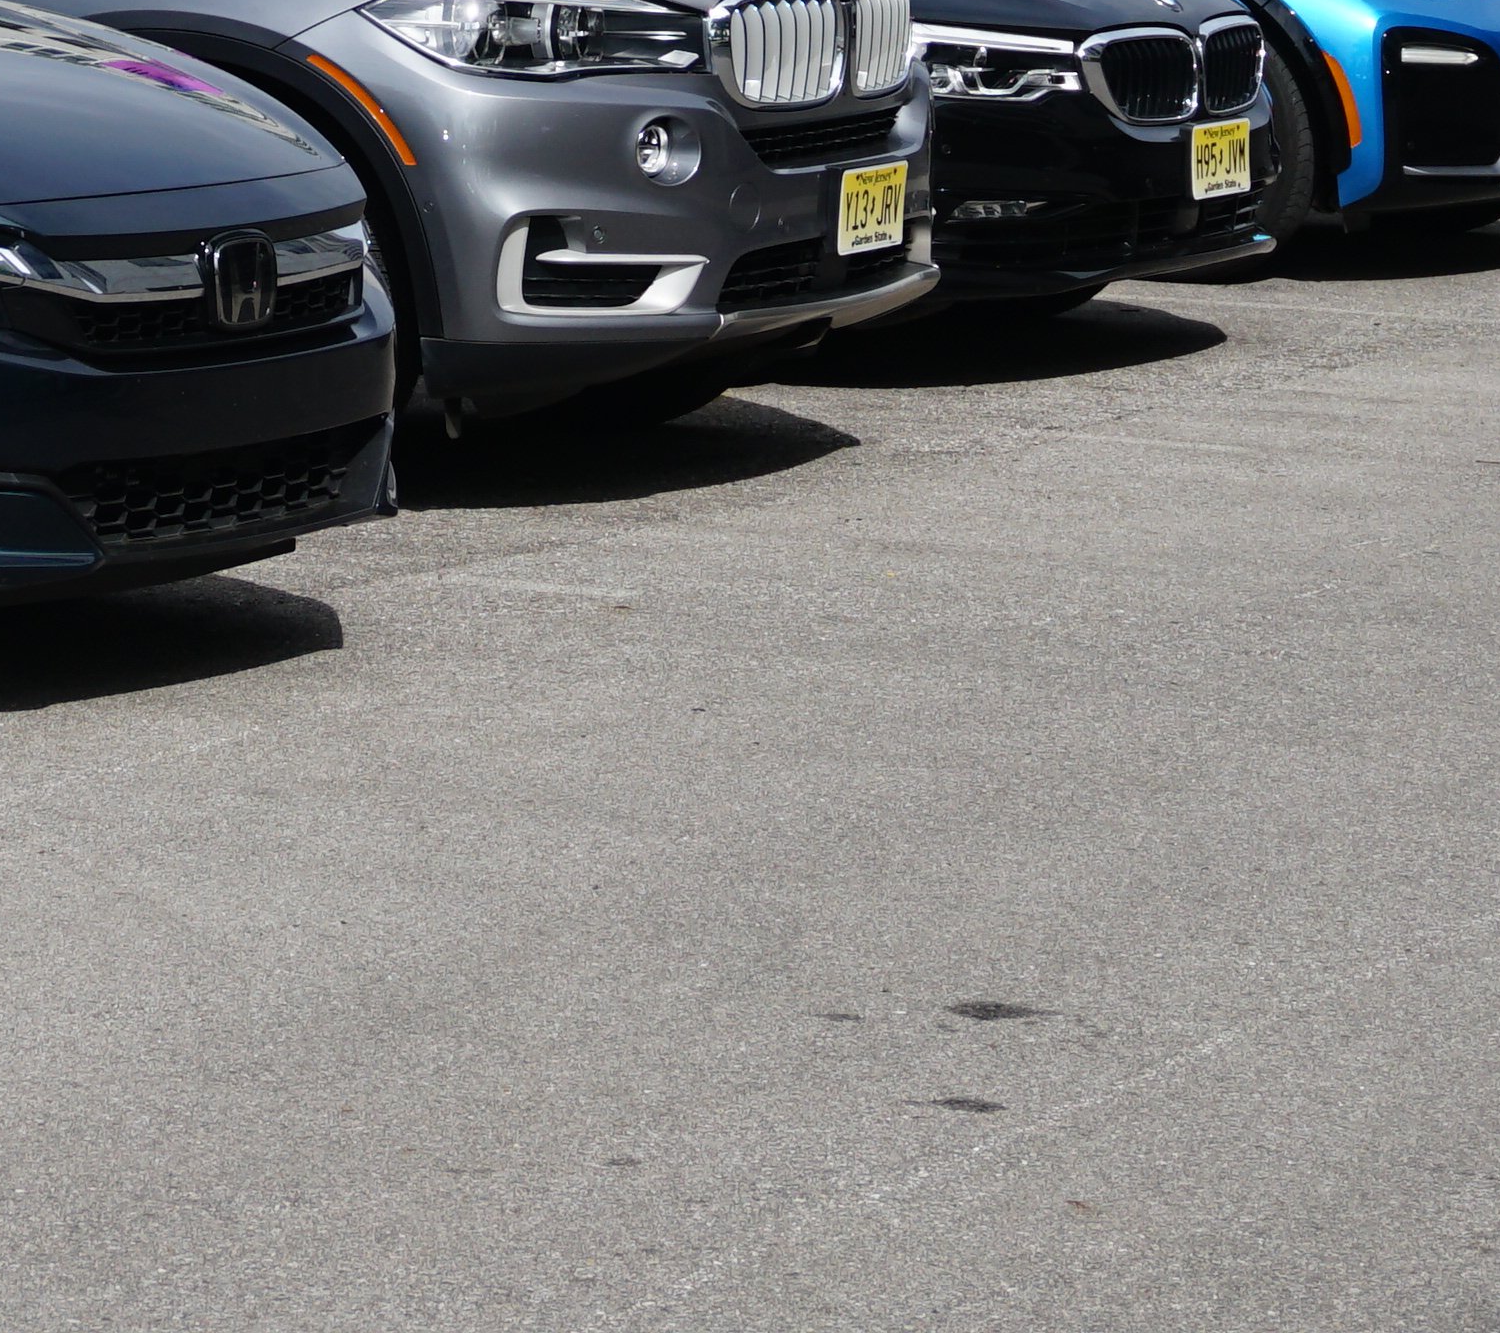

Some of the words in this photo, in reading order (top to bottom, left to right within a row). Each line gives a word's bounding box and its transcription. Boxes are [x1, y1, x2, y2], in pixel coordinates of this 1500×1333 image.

[1196, 141, 1218, 180] H95
[846, 188, 870, 232] Y13
[876, 183, 902, 226] JRV
